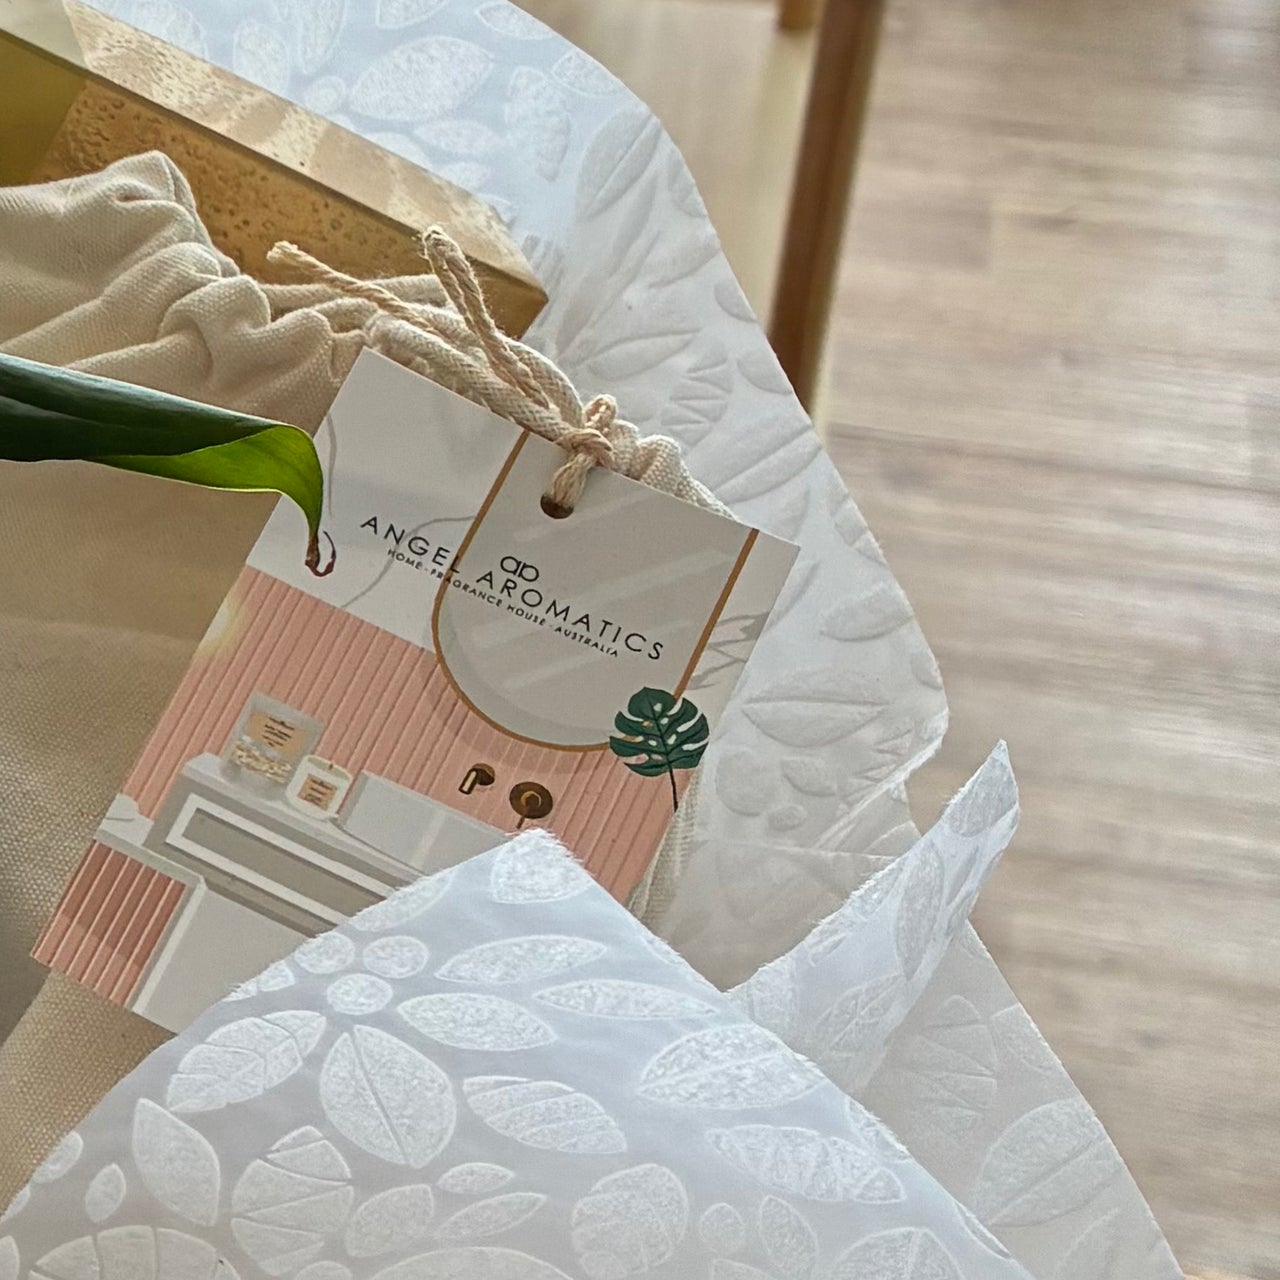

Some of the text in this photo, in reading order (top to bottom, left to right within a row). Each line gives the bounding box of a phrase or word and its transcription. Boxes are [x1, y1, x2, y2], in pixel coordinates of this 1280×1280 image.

[360, 516, 664, 660] ANGEL AROMATICS
[387, 549, 424, 571] HOME
[507, 603, 547, 627] HOUSE
[554, 625, 619, 658] AUSTRALIA
